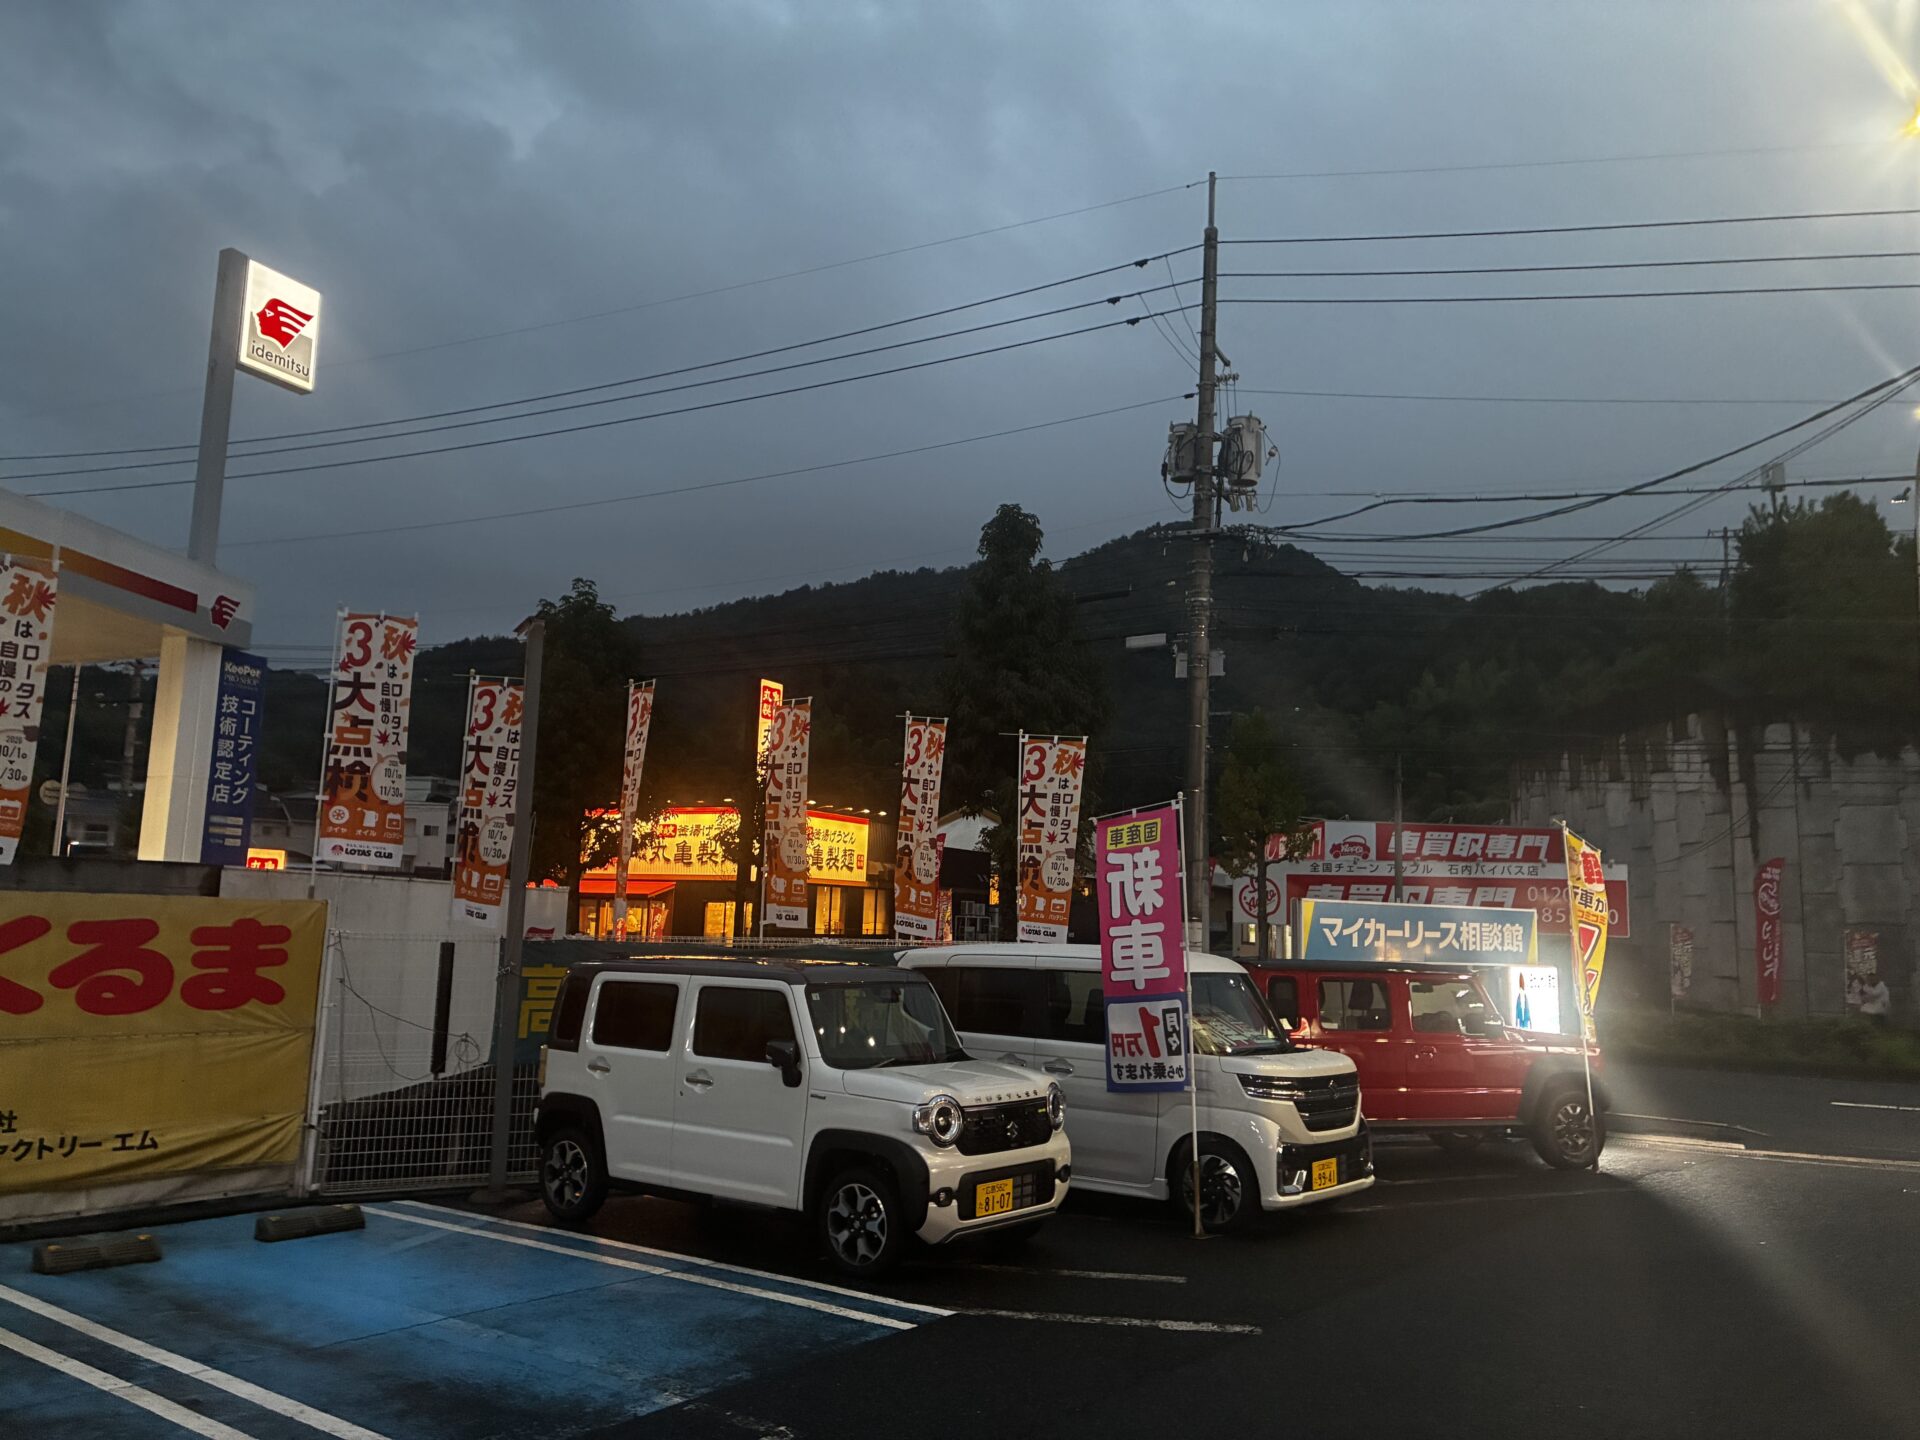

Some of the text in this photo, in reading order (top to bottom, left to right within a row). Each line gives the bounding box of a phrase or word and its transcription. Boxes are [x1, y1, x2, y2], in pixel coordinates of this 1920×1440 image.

[251, 340, 310, 377] idemitsu
[13, 644, 41, 720] ロータス
[390, 683, 403, 746] ロータス
[211, 694, 240, 804] 技術認定店
[232, 699, 256, 804] コーティング
[492, 746, 509, 787] 自慢の
[500, 749, 520, 808] ロータス
[792, 762, 803, 818] ロータス
[925, 780, 936, 833] ロータス
[1050, 793, 1061, 827] 自慢の
[1059, 793, 1074, 843] ロータス
[345, 848, 393, 859] LOTAS CLUB
[649, 840, 726, 866] 丸亀製
[810, 843, 856, 873] 亀製麺
[1387, 830, 1550, 865] 車買取専門
[1047, 876, 1066, 887] 11/30
[1309, 862, 1539, 877] 全国チェーン アップル 石内バイパス店
[1025, 928, 1041, 936] LOTAS
[1318, 917, 1524, 953] マイカーリース相談館
[0, 914, 292, 1015] くるま
[974, 1089, 1038, 1103] HUSTLER
[112, 1130, 158, 1151] エム
[984, 1191, 1011, 1212] 81-07
